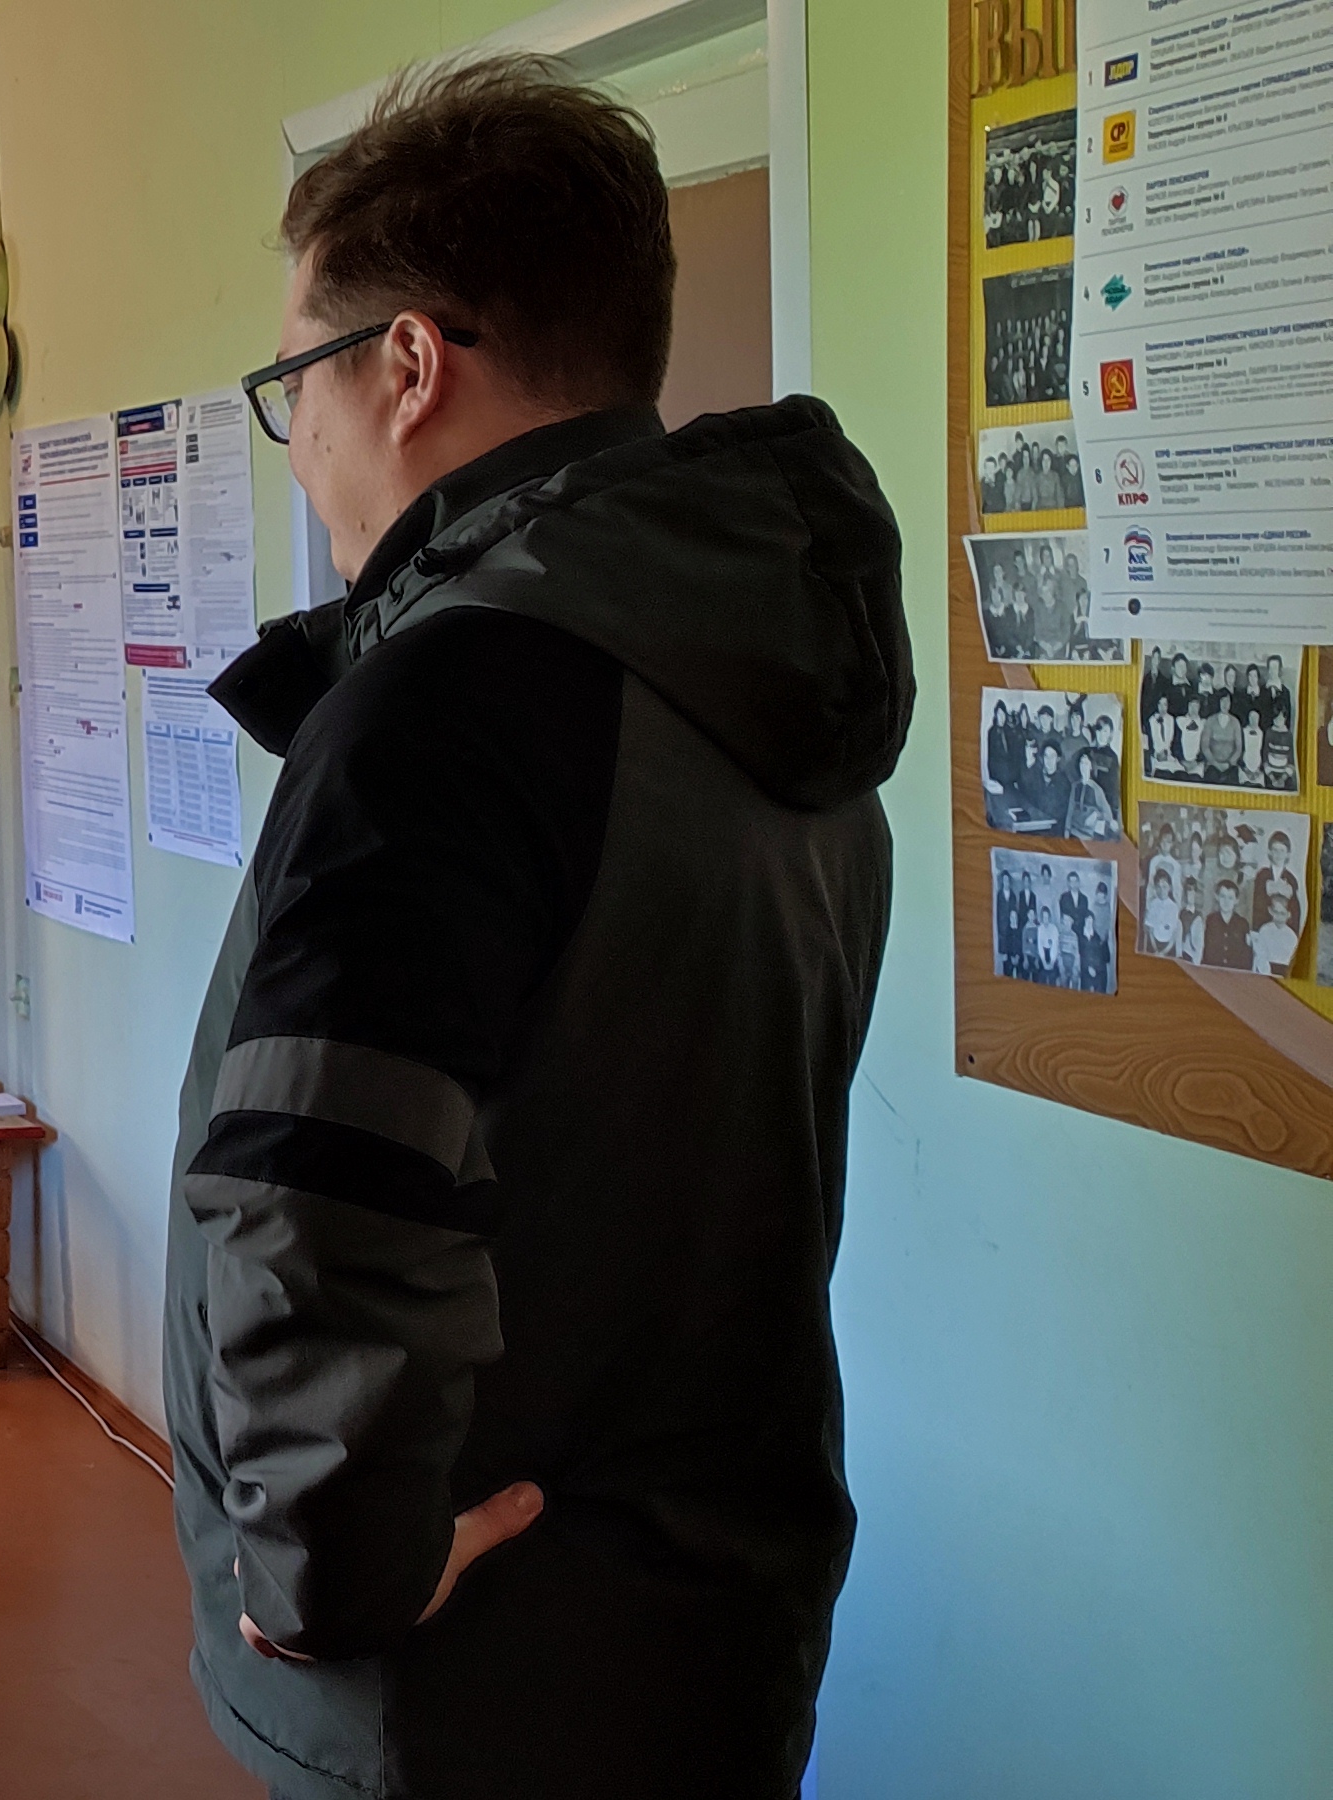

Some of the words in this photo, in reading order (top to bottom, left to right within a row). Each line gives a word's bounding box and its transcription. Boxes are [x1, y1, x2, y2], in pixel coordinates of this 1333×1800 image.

[971, 0, 1075, 99] ВЫ
[1083, 381, 1089, 396] 5
[1095, 468, 1102, 484] 6
[1117, 491, 1150, 506] КПРФ
[1103, 547, 1109, 564] 7
